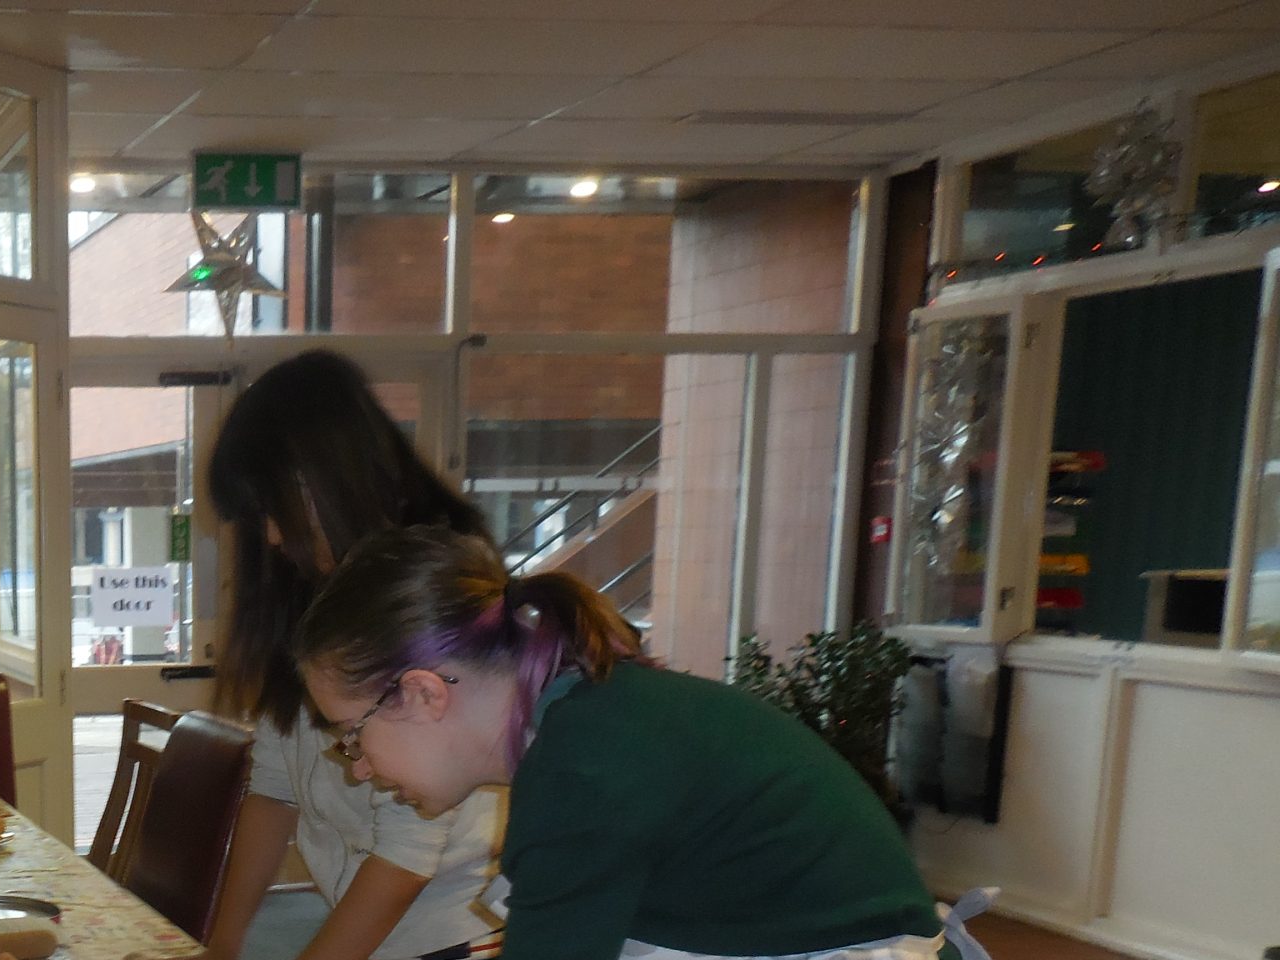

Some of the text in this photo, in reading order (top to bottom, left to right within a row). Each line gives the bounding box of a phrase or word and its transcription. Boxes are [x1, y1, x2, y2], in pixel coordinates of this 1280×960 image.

[99, 574, 168, 589] Use this
[112, 599, 153, 612] door
